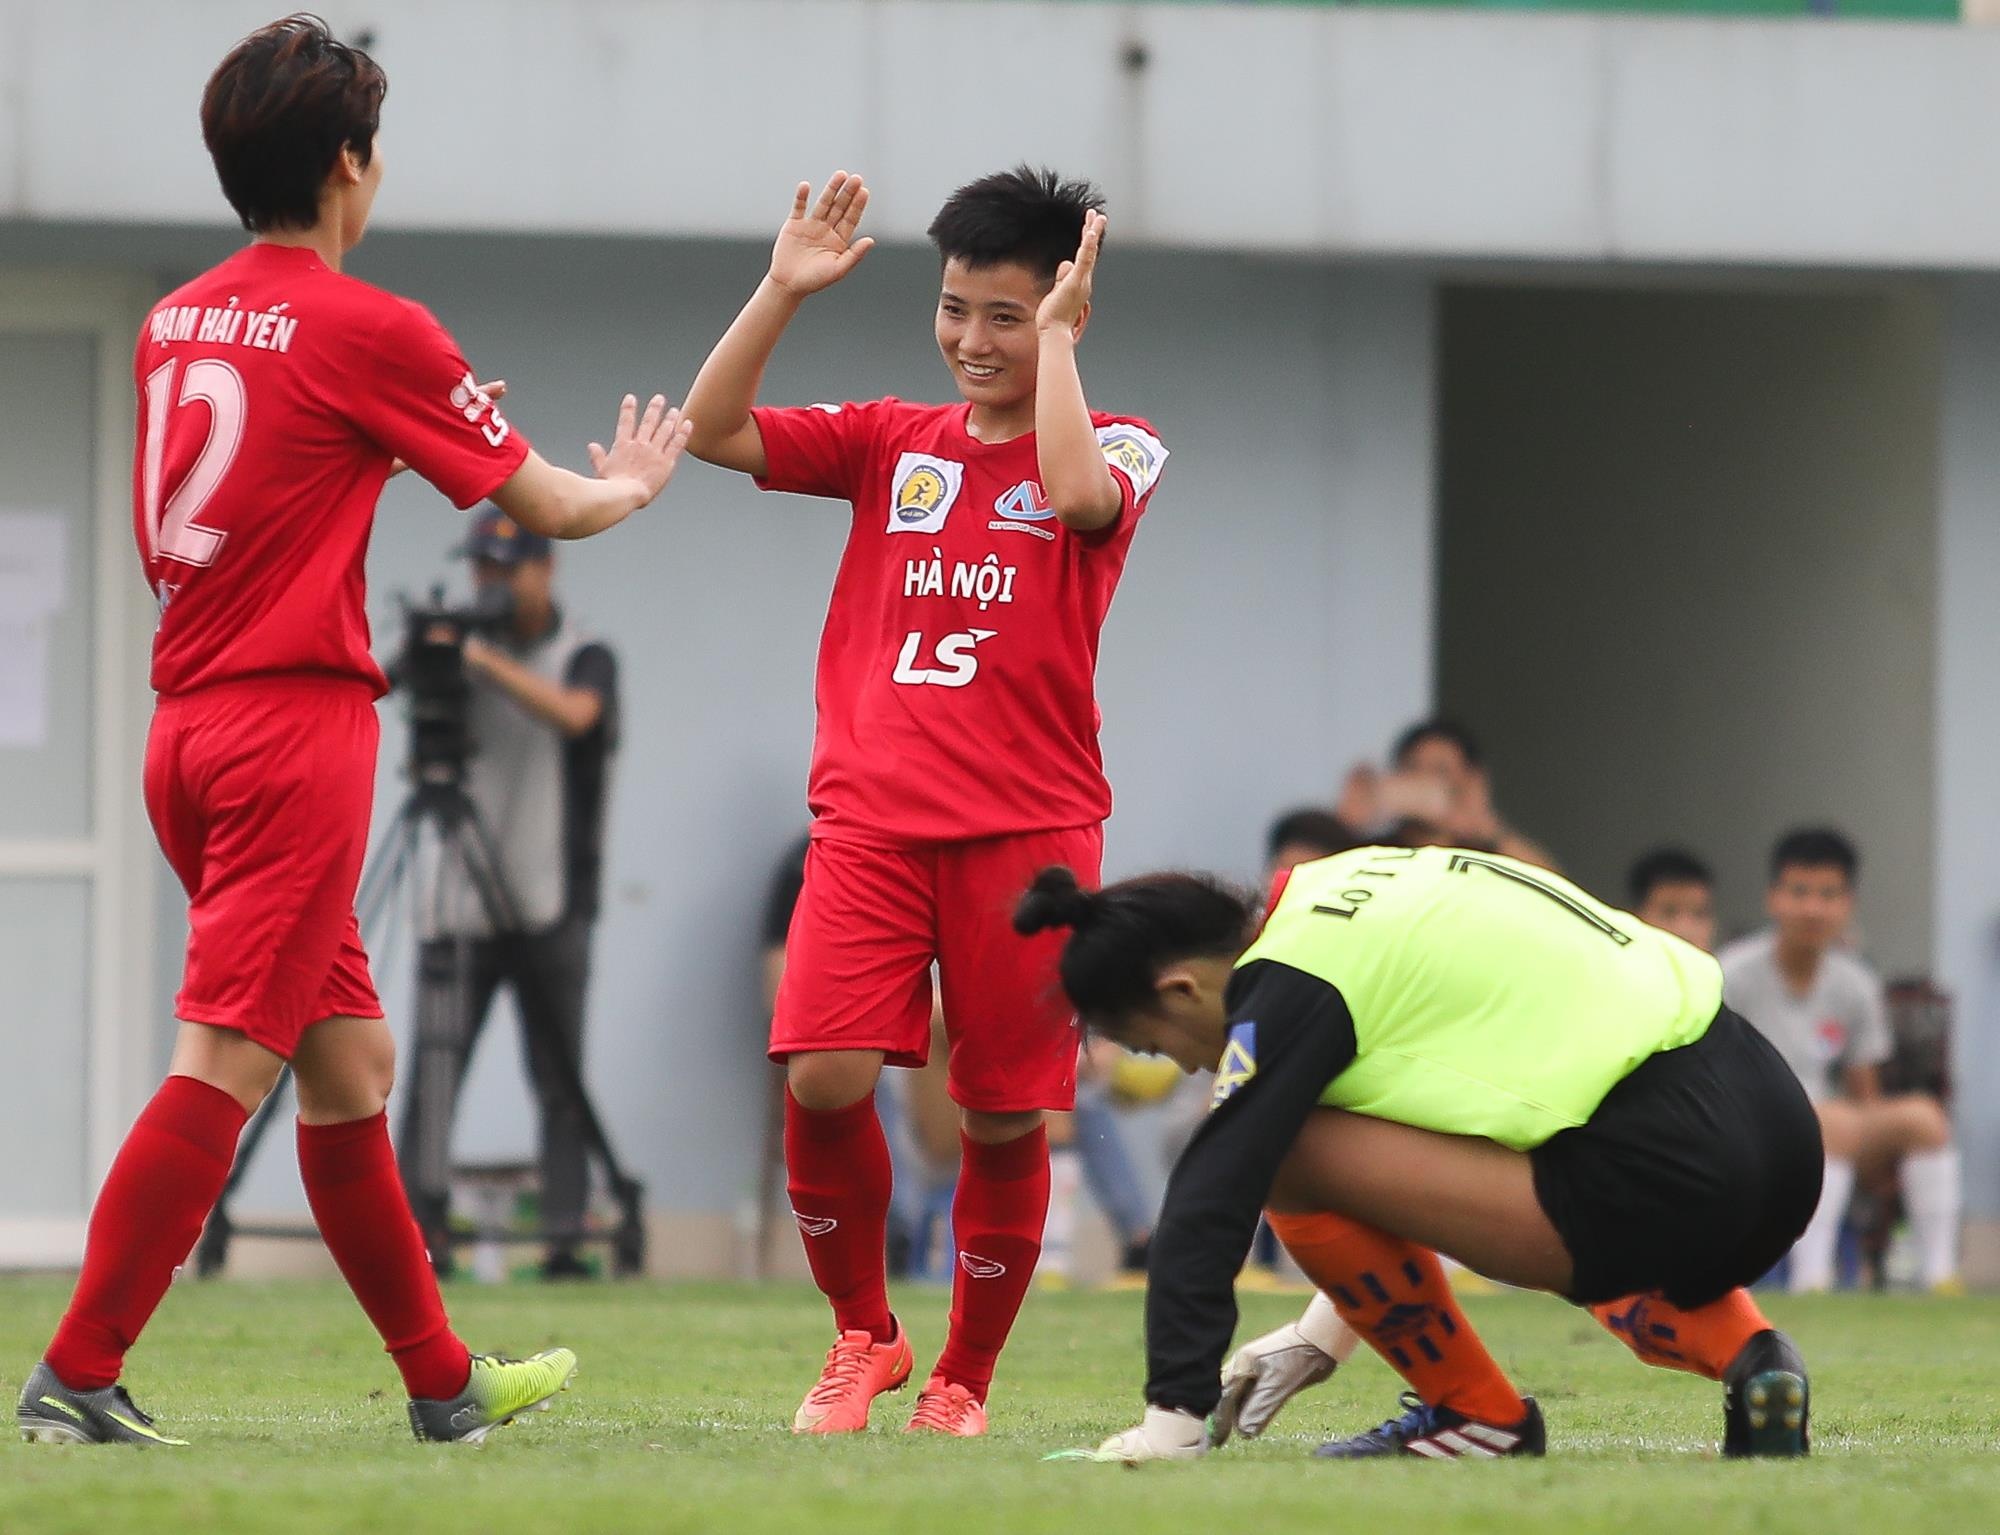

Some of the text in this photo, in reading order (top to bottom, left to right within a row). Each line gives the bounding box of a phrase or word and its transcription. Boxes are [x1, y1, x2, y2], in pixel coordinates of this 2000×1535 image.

[197, 295, 244, 344] HẢI
[242, 302, 298, 353] YẾN
[143, 356, 246, 567] 12
[904, 546, 1017, 611] HÀ NỘI
[892, 628, 998, 687] LS
